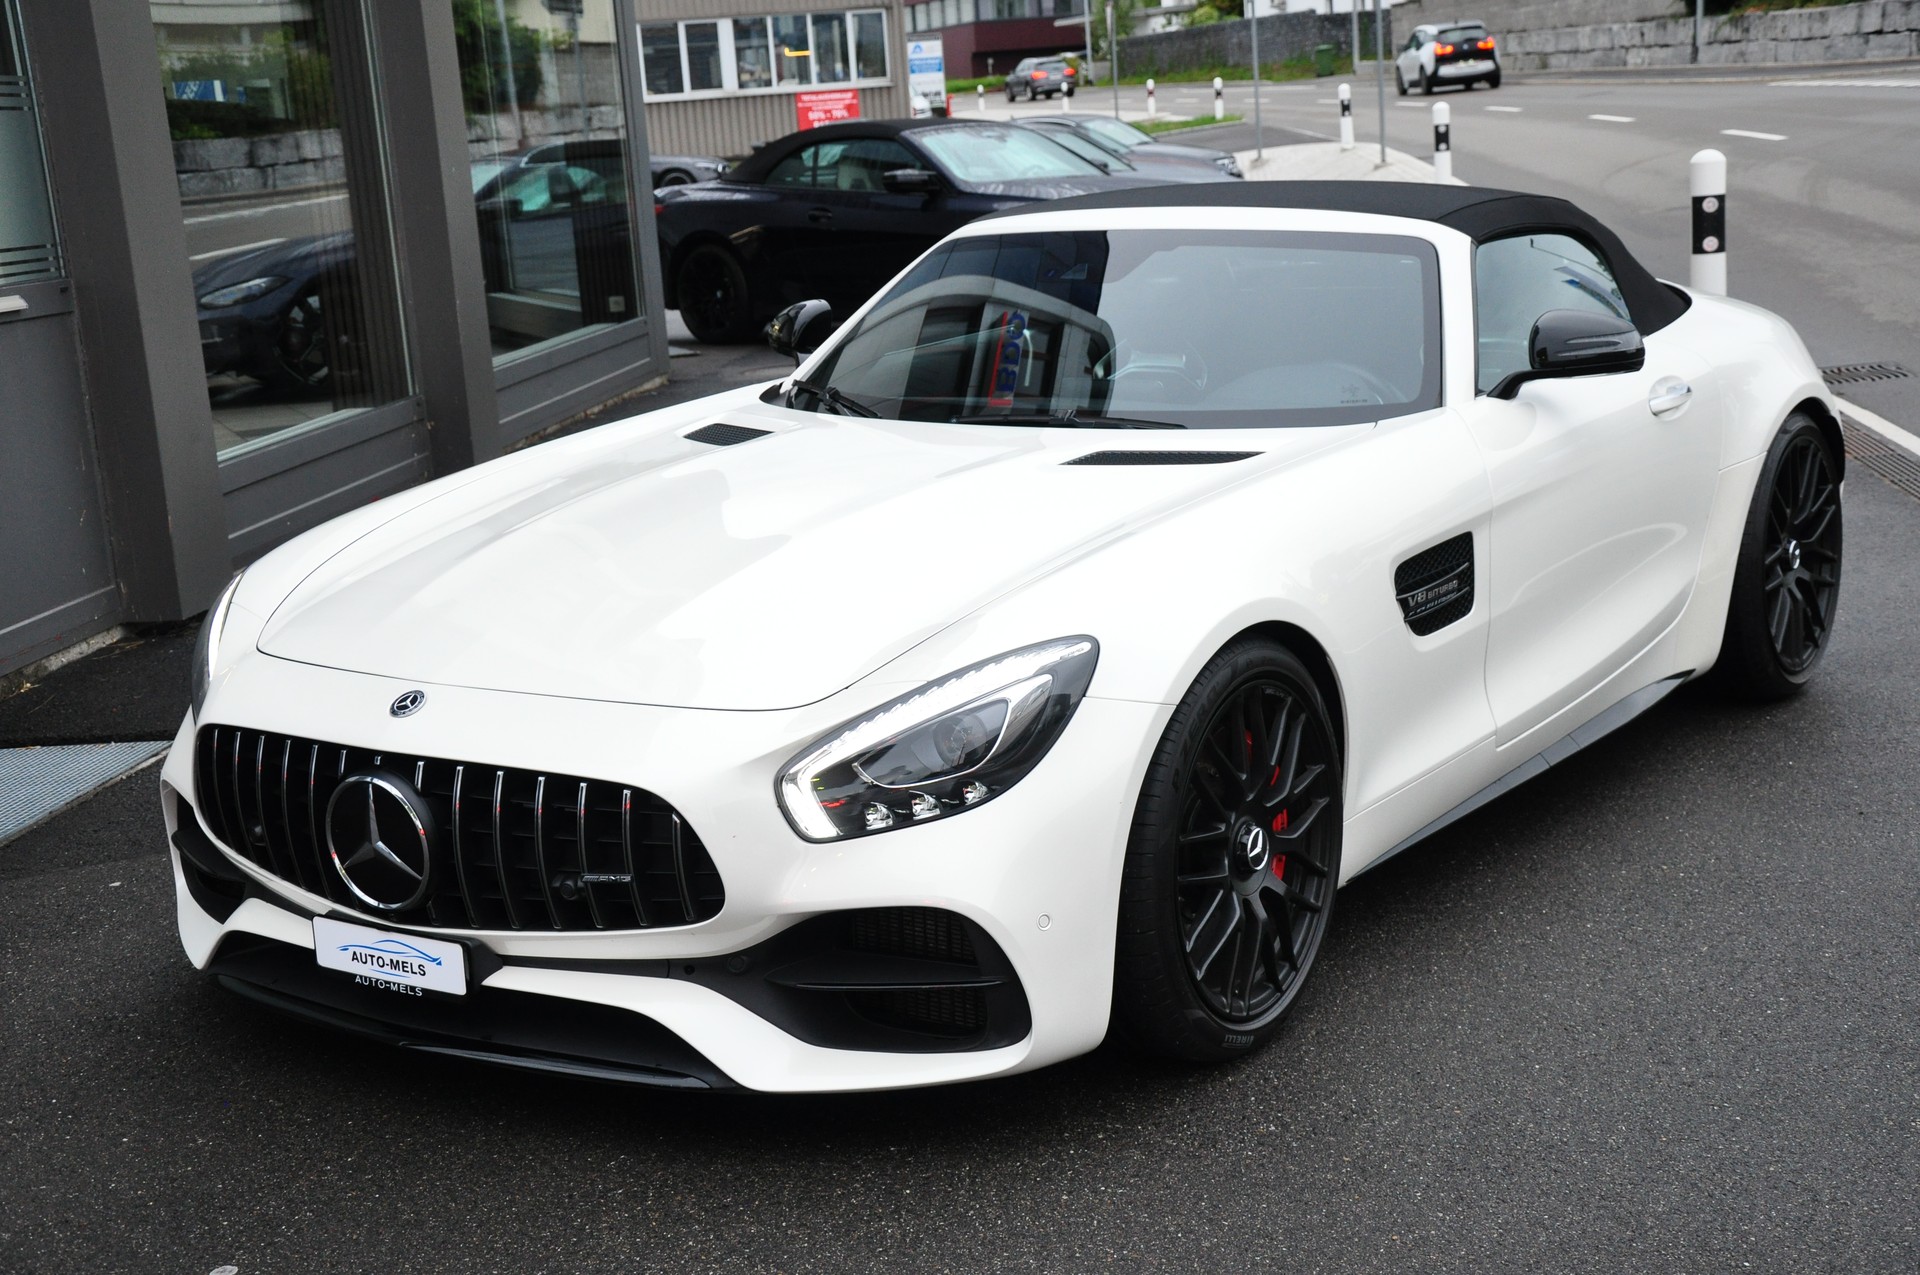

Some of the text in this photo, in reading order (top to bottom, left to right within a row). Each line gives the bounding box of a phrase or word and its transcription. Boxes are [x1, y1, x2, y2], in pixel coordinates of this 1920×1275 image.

[1407, 590, 1427, 607] V8
[1427, 579, 1458, 599] BITURBO
[351, 950, 427, 977] AUTO-MELS
[355, 975, 423, 997] AUTO-MELS
